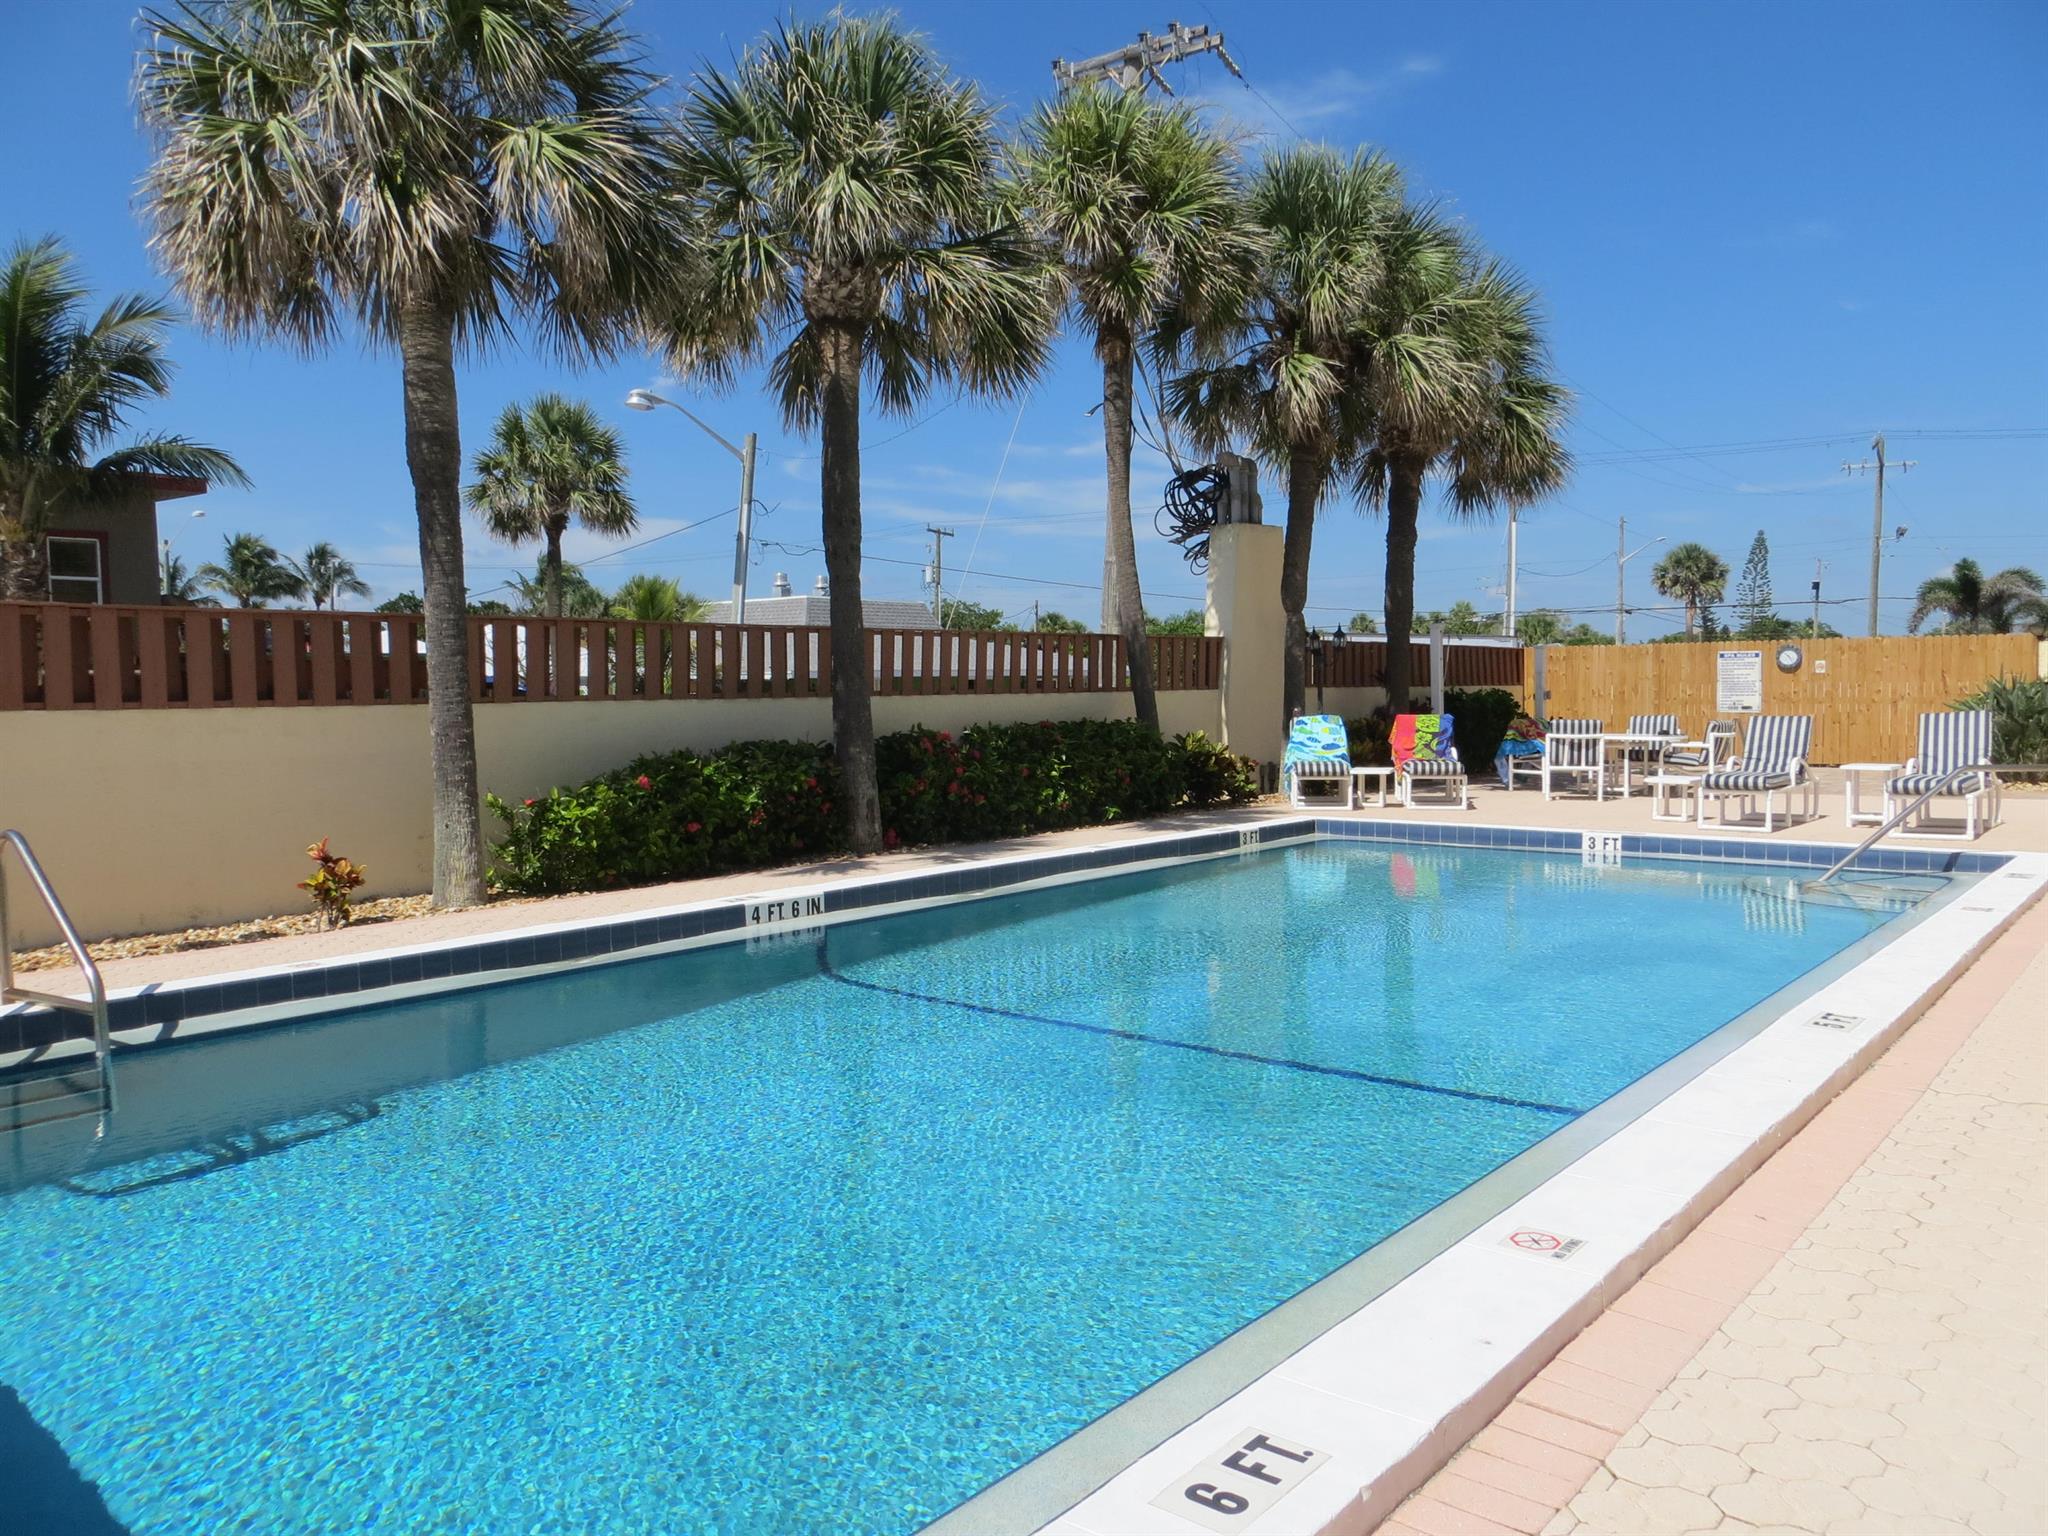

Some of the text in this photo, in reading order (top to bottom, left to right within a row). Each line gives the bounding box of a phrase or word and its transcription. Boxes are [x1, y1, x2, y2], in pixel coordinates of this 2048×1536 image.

[1242, 832, 1248, 845] 3
[1588, 836, 1596, 850] 3
[752, 906, 760, 924] 4
[792, 900, 800, 918] 6
[806, 897, 824, 916] IN.
[1184, 1434, 1314, 1515] 6 FT.
